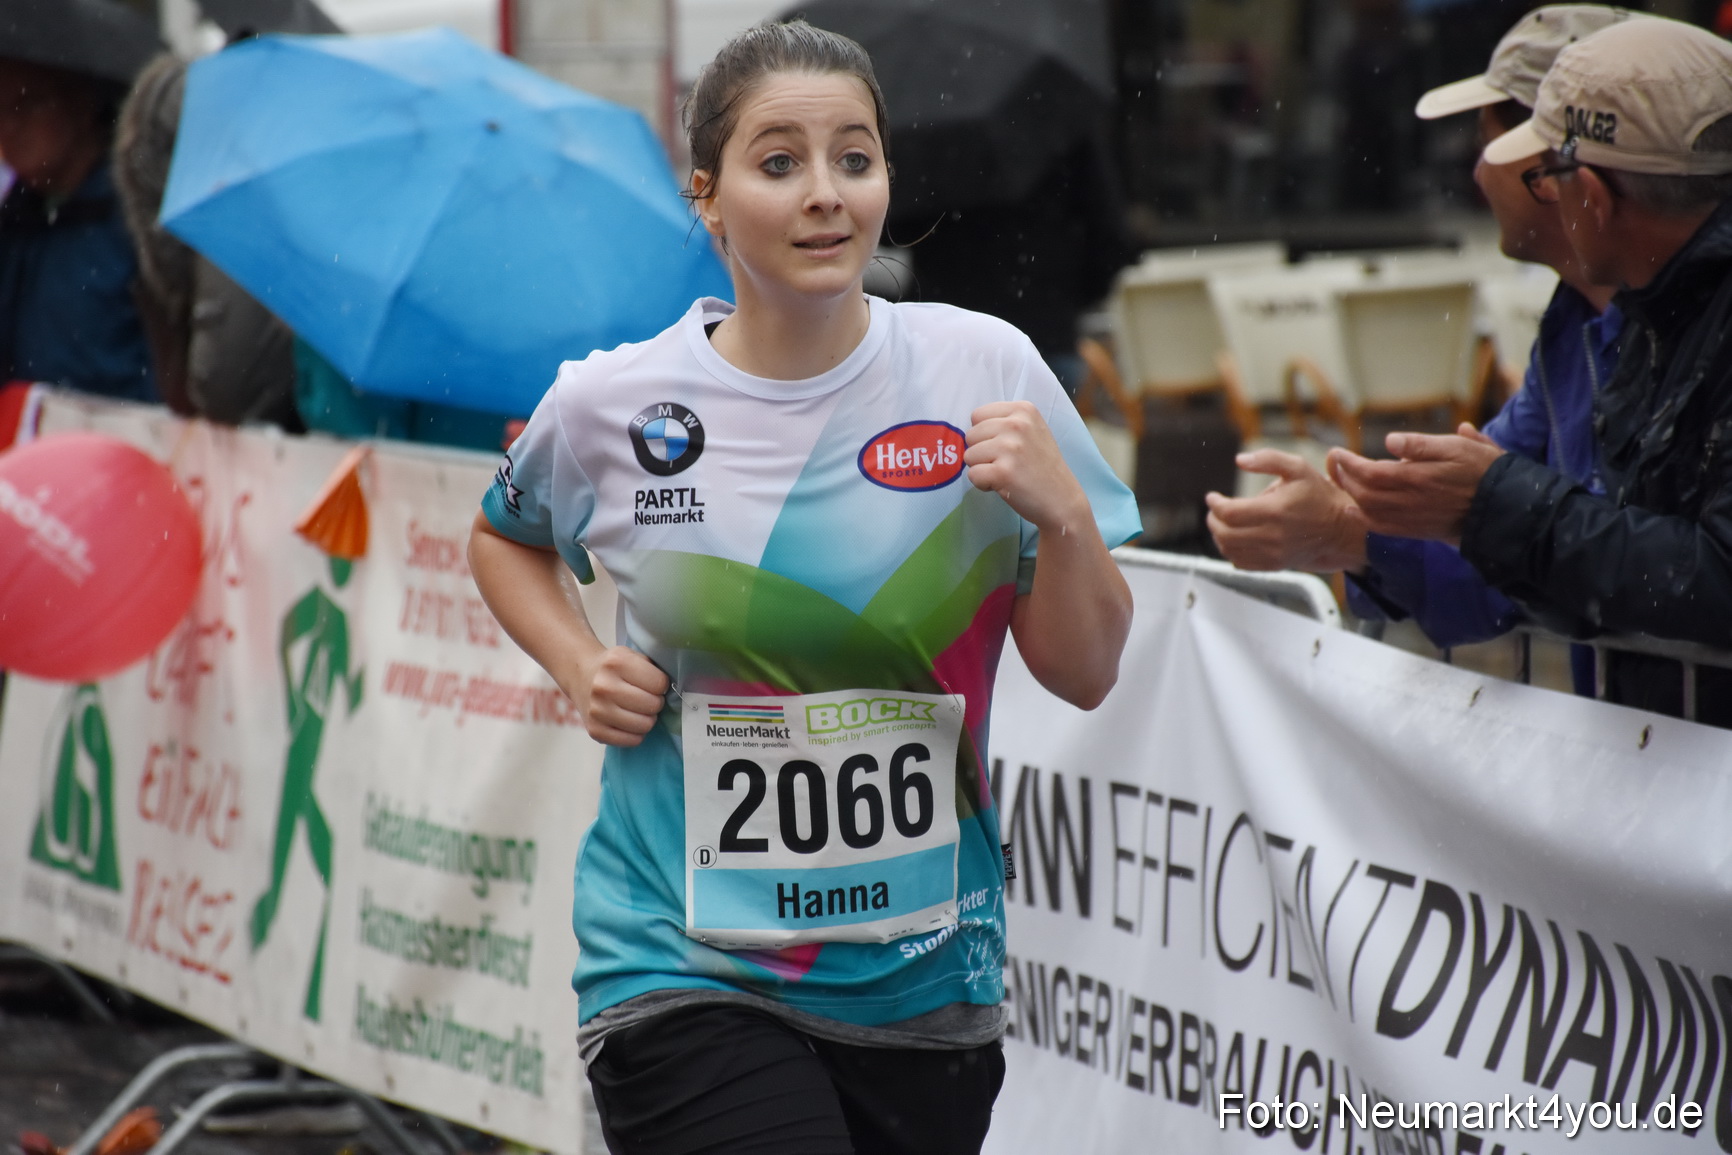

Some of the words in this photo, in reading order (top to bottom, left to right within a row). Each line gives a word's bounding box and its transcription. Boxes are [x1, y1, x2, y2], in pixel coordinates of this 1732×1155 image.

[633, 404, 699, 429] BMW
[876, 439, 958, 472] Hervis
[882, 468, 923, 478] SPORTS
[635, 488, 705, 509] PARTL
[634, 509, 704, 525] Neumarkt
[806, 697, 938, 734] BOCK
[706, 725, 791, 739] NeuerMarkt
[808, 735, 849, 746] inspired
[851, 731, 861, 742] by
[863, 724, 890, 737] smart
[892, 722, 937, 732] concepts
[717, 742, 934, 854] 2066
[700, 849, 711, 865] D
[776, 881, 889, 919] Hanna
[957, 887, 989, 915] rkter
